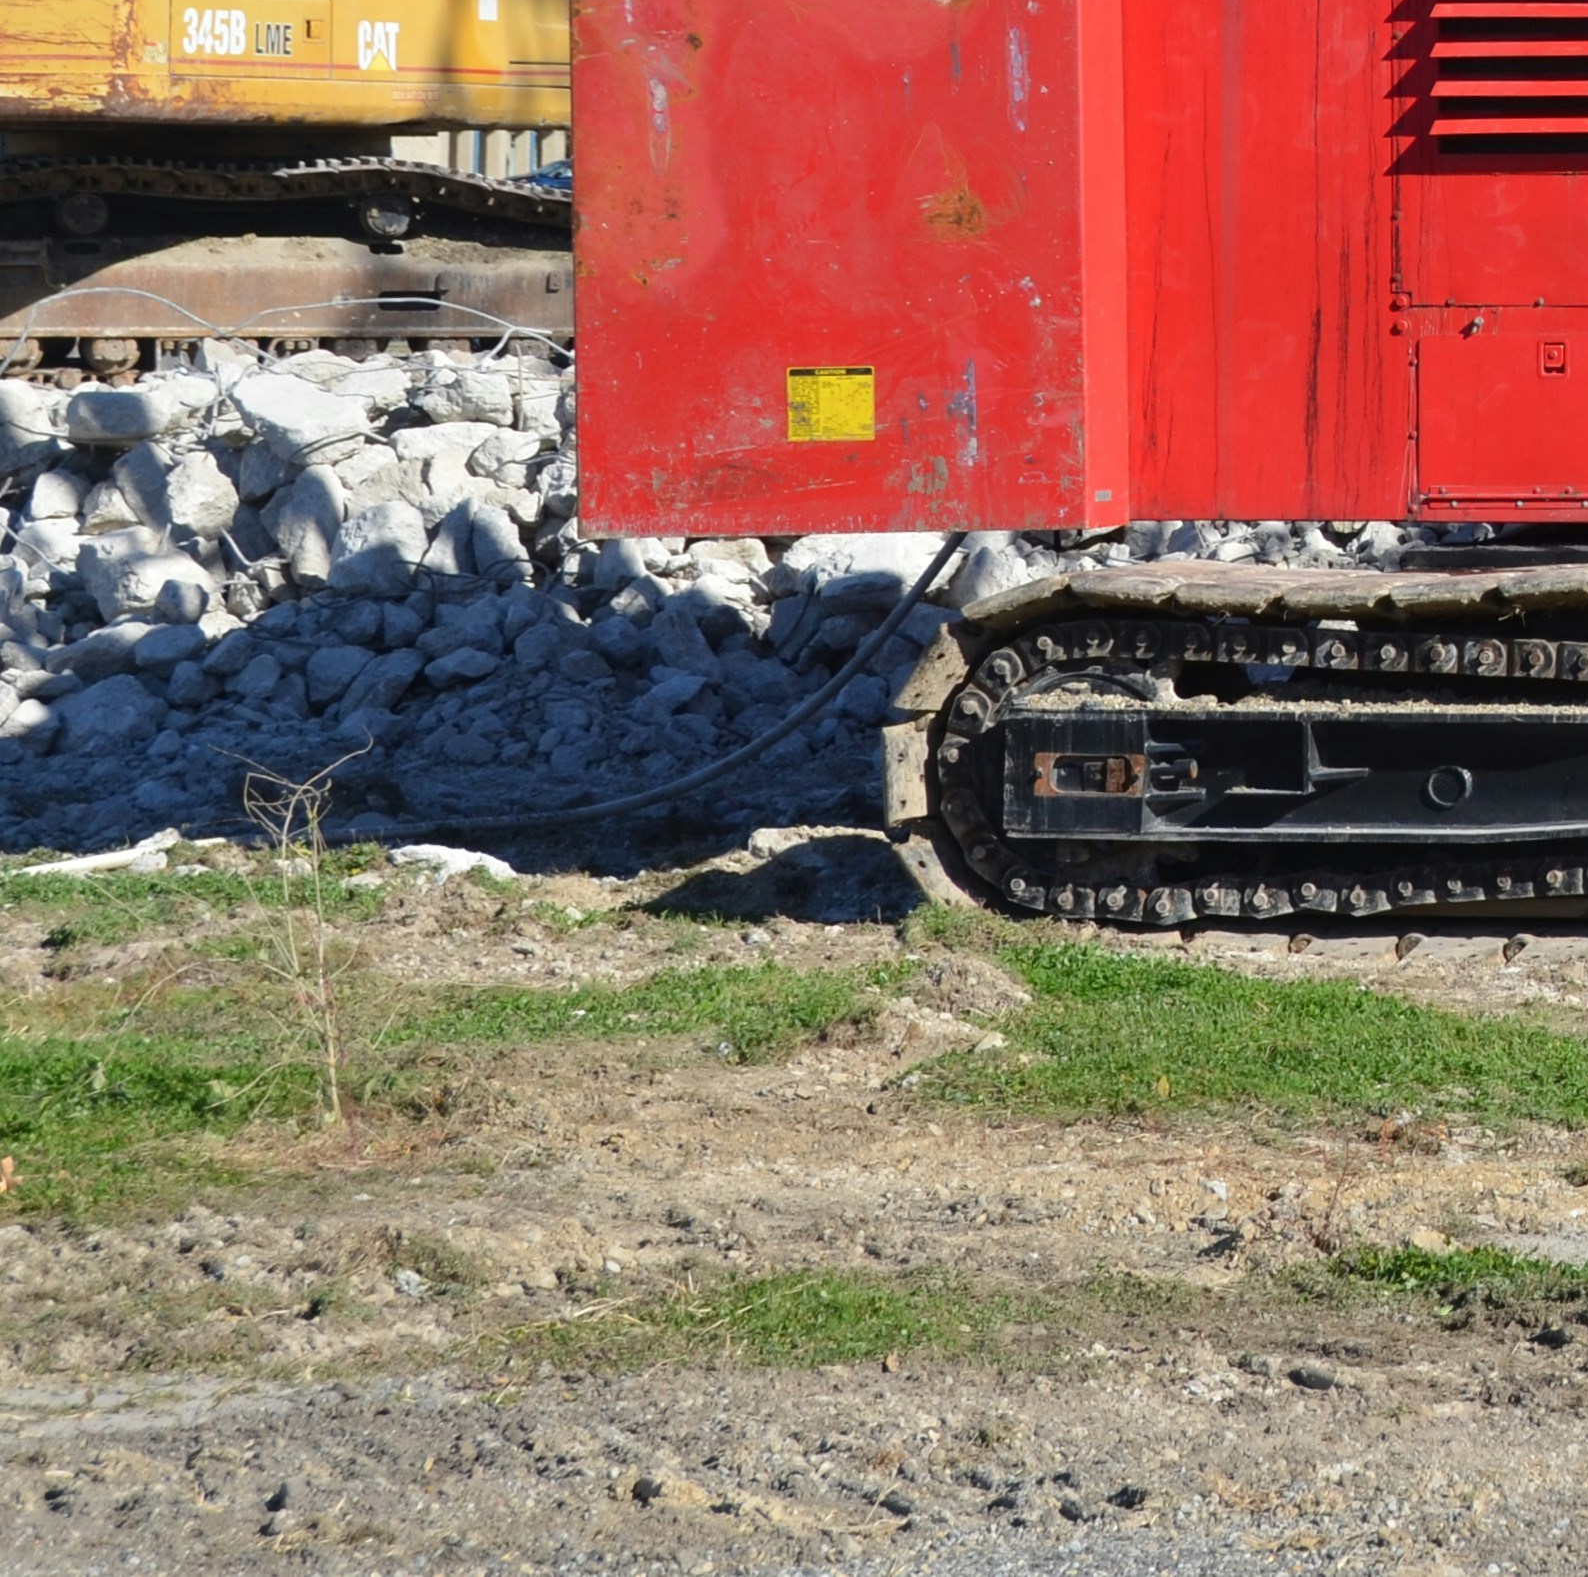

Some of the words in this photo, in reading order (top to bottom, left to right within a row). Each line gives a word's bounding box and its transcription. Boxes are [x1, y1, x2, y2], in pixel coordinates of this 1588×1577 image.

[183, 7, 246, 55] 345B
[254, 22, 292, 56] LME
[358, 20, 399, 71] CAT
